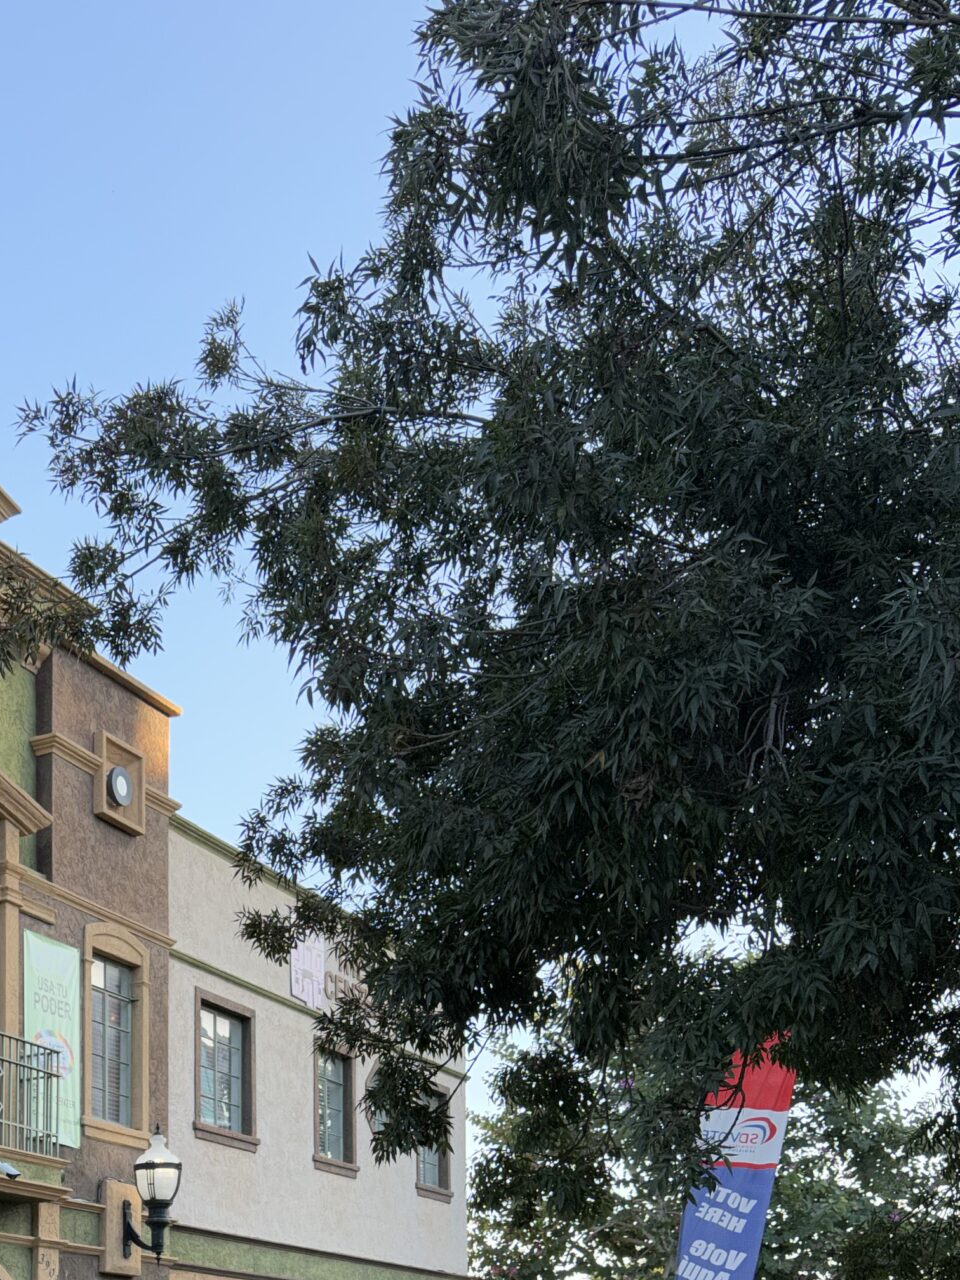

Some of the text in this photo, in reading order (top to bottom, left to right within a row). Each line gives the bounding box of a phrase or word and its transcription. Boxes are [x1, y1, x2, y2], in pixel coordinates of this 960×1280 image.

[38, 975, 68, 998] USA TU
[33, 991, 72, 1021] PODER
